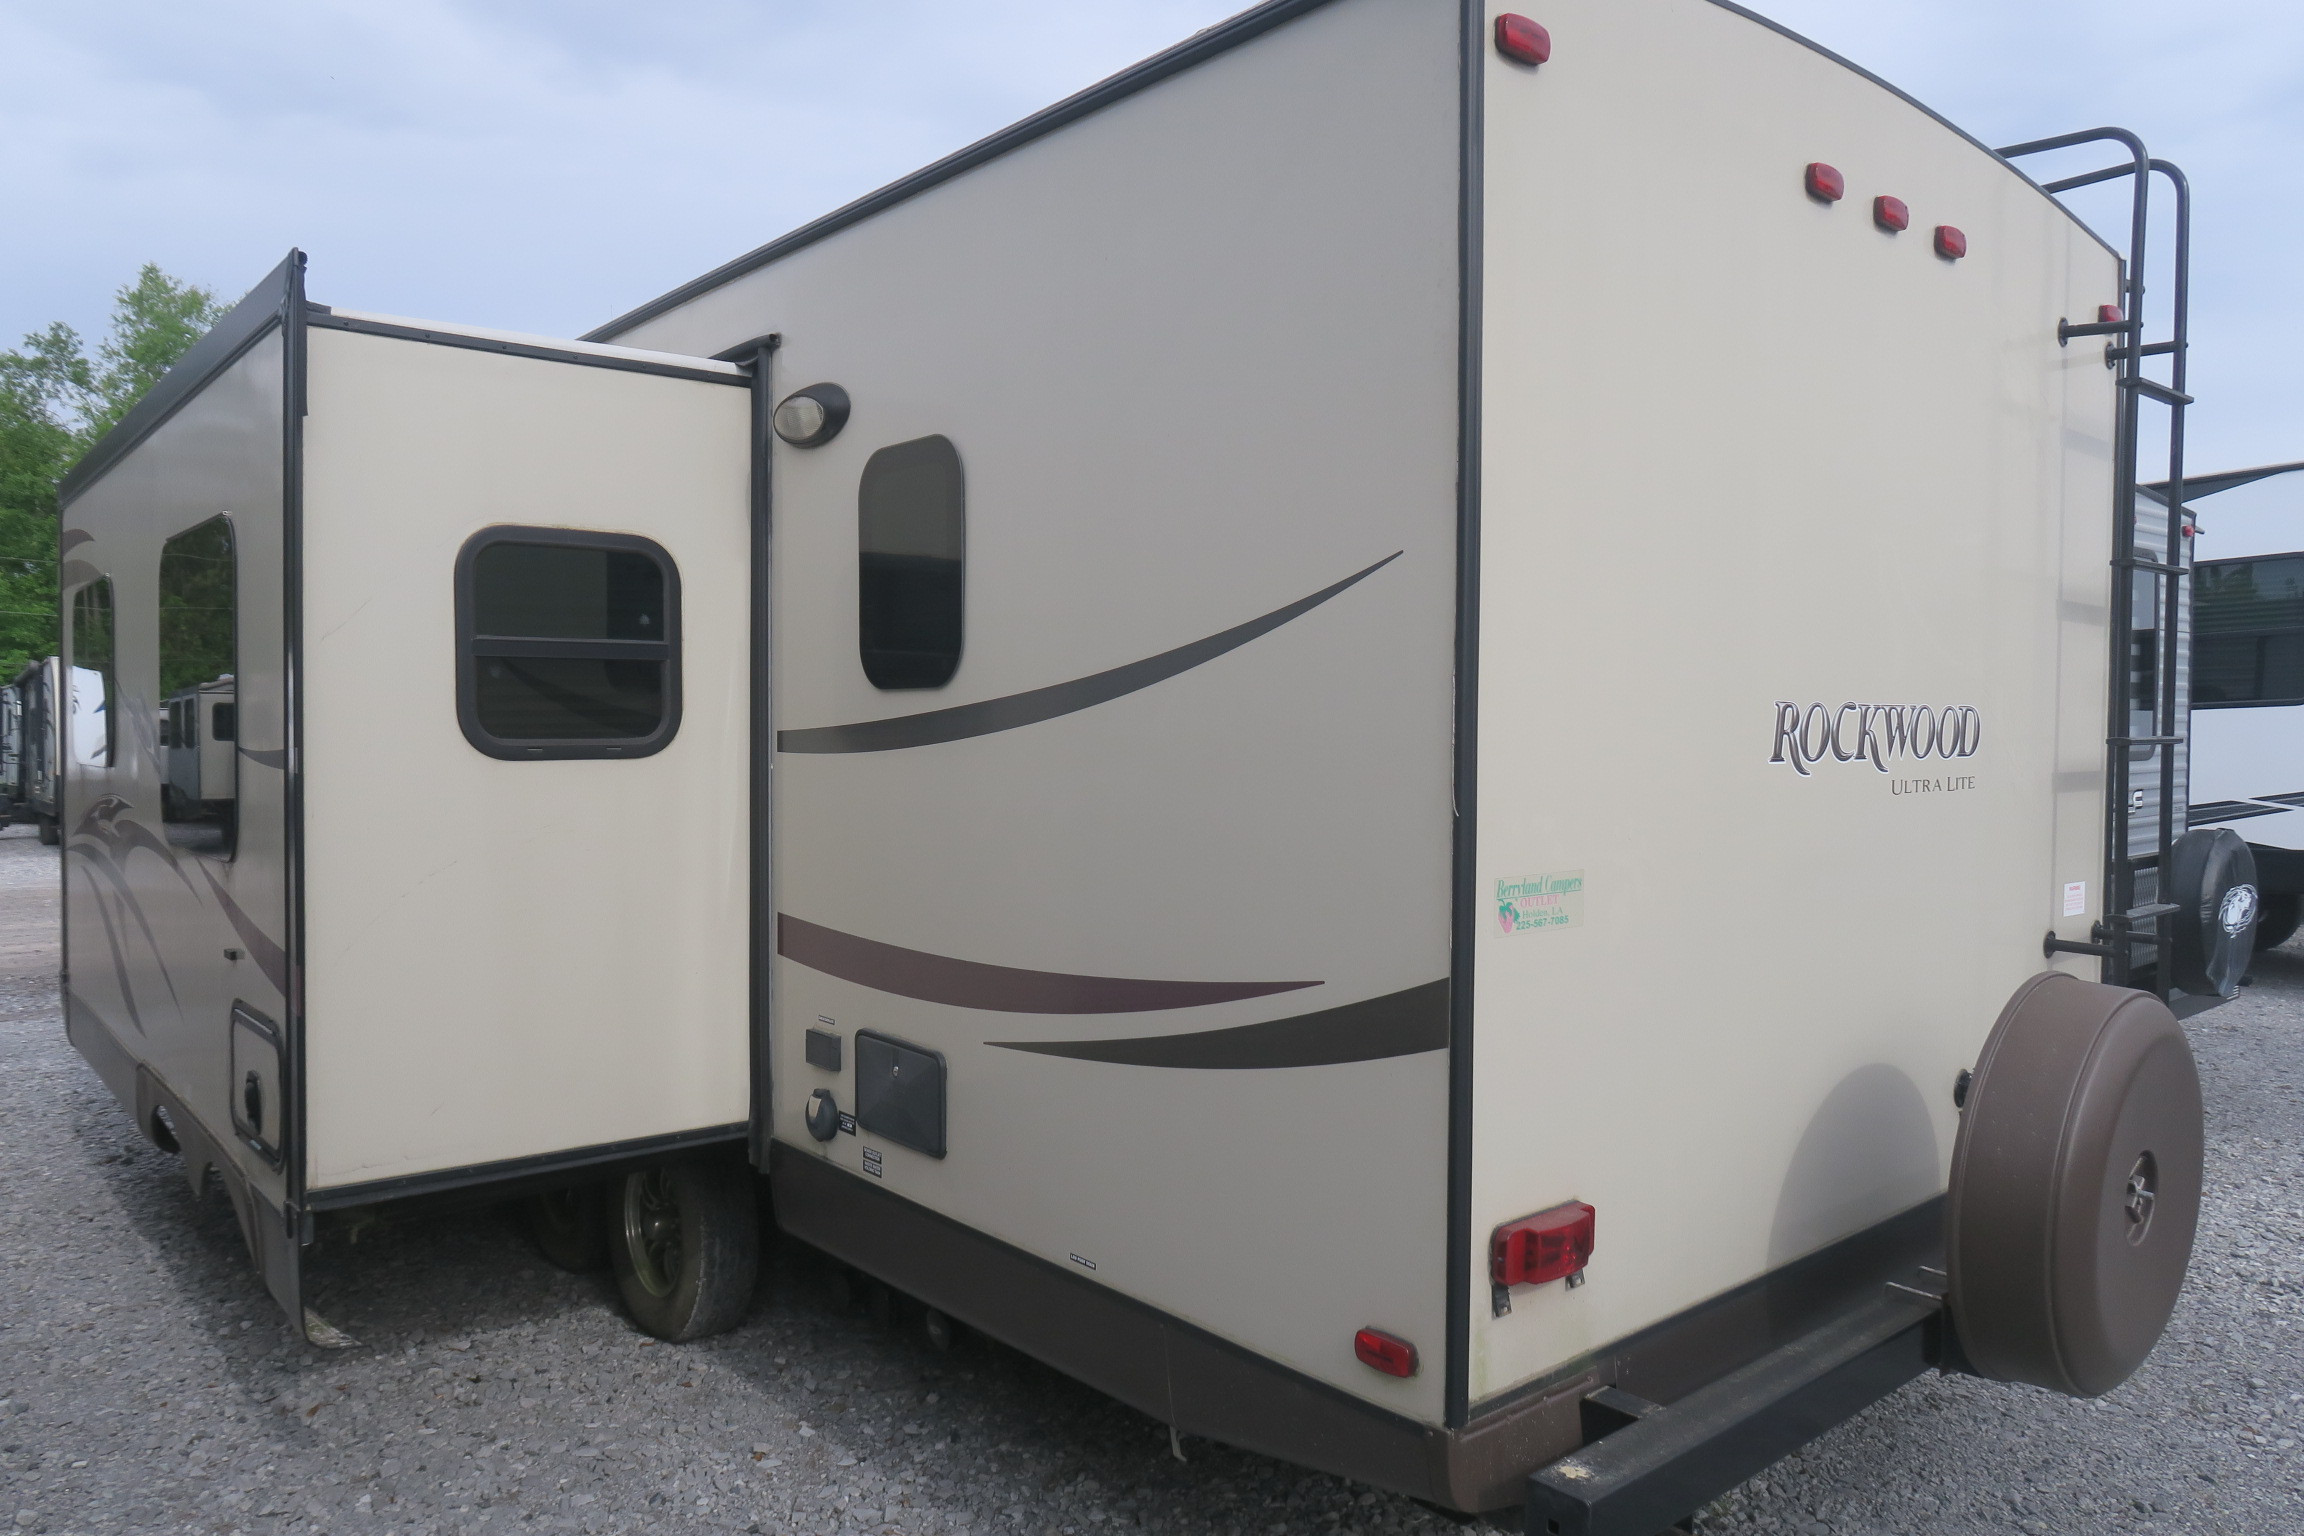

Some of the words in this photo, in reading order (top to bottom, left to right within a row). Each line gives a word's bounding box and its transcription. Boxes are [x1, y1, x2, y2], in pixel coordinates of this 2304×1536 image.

[1768, 700, 1981, 776] ROCKWOOD
[1891, 779, 1942, 795] ULTRA
[1946, 775, 1976, 792] LITE
[1497, 876, 1543, 900] Berryland
[1545, 875, 1582, 896] Campers
[1520, 894, 1560, 908] OUTLET
[1516, 915, 1569, 930] 225-567-7085
